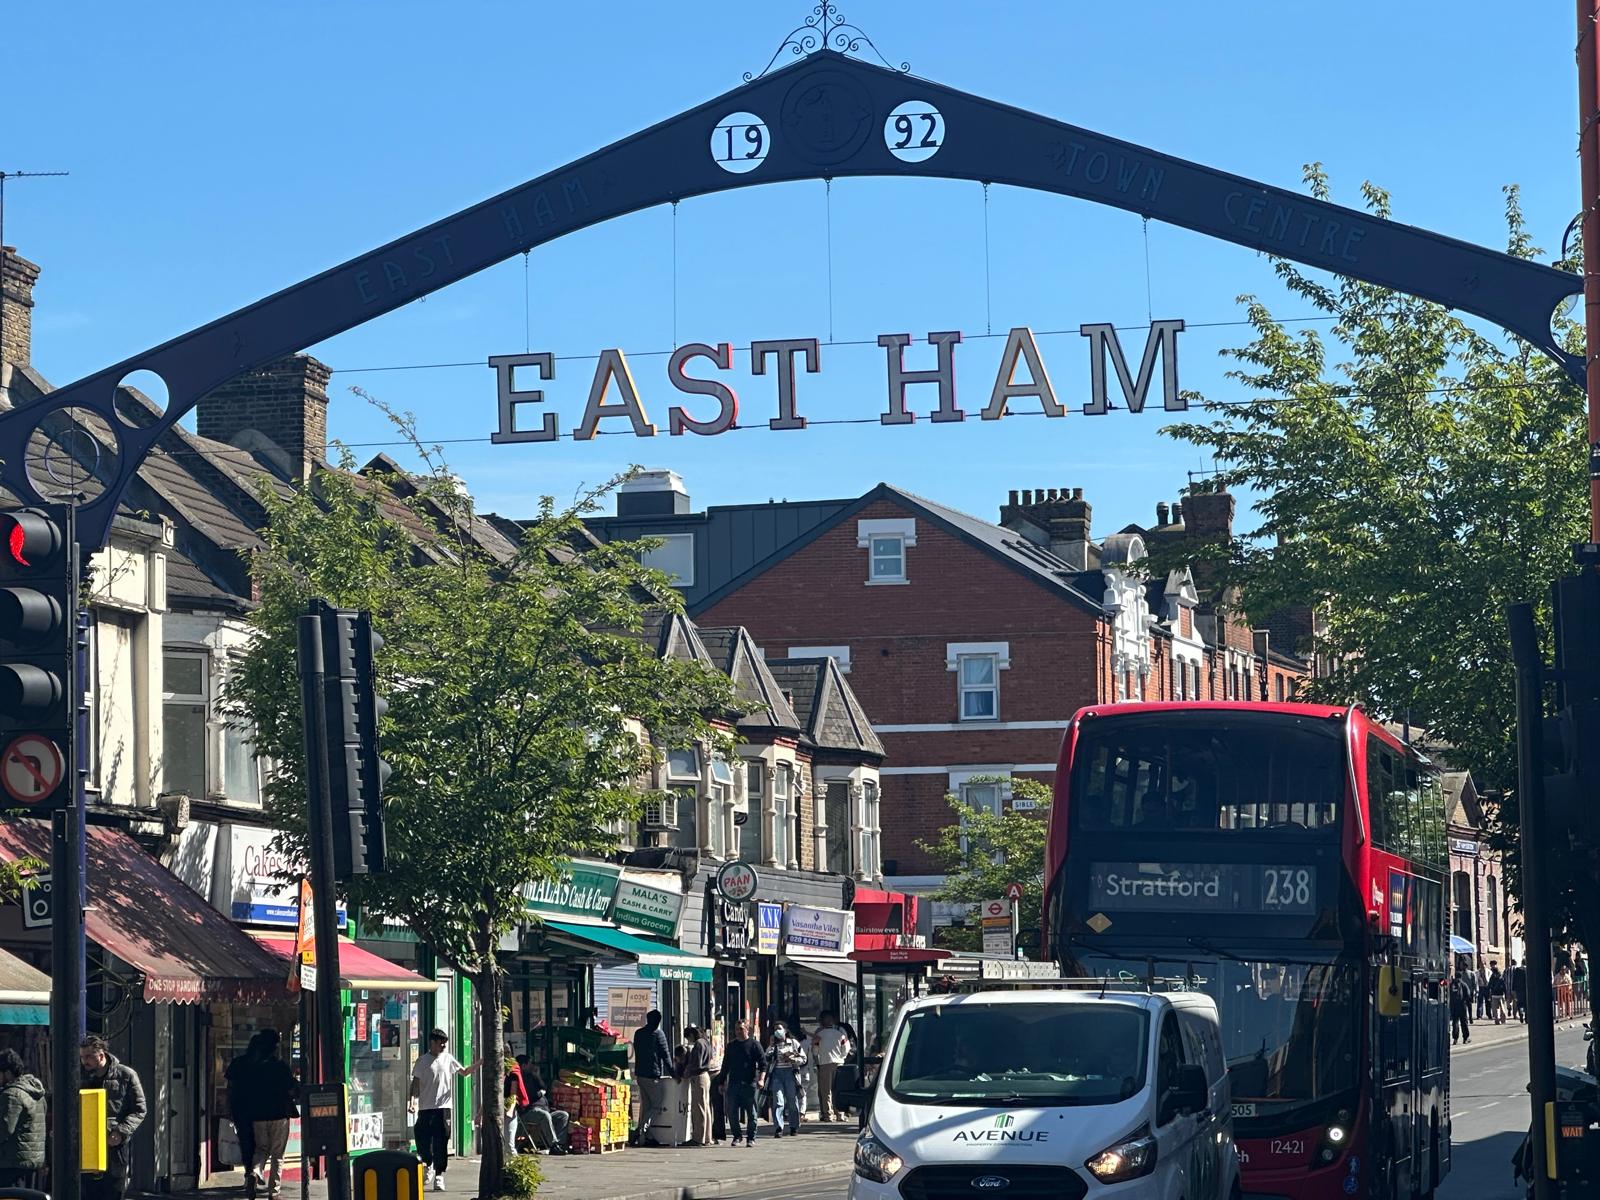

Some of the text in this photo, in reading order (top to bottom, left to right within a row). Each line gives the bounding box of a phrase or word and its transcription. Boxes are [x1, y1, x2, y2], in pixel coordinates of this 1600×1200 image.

[723, 124, 763, 161] 19
[894, 113, 938, 149] 92
[1065, 140, 1367, 263] TOWN CENTRE
[353, 176, 592, 304] EAST HAM
[488, 319, 1188, 443] EAST HAM
[245, 845, 283, 877] Cakes
[724, 873, 750, 888] PAAN
[1009, 886, 1020, 898] A
[1106, 874, 1219, 897] Stratford
[1264, 869, 1310, 905] 238
[569, 885, 586, 909] Cash
[585, 887, 593, 910] &
[592, 888, 611, 915] Carry
[631, 887, 668, 905] MALA'S
[621, 898, 674, 918] CASH & CARRY
[724, 901, 749, 929] Candy
[760, 907, 780, 928] KNK
[616, 911, 672, 934] Indian Grocery
[725, 926, 746, 949] Land
[149, 978, 162, 991] ONE
[162, 978, 175, 992] STOP
[312, 1106, 337, 1117] WAIT
[953, 1130, 1049, 1142] AVENUE
[1562, 1126, 1584, 1137] WAIT
[1270, 1140, 1304, 1154] 12421
[979, 1176, 1001, 1187] Ford
